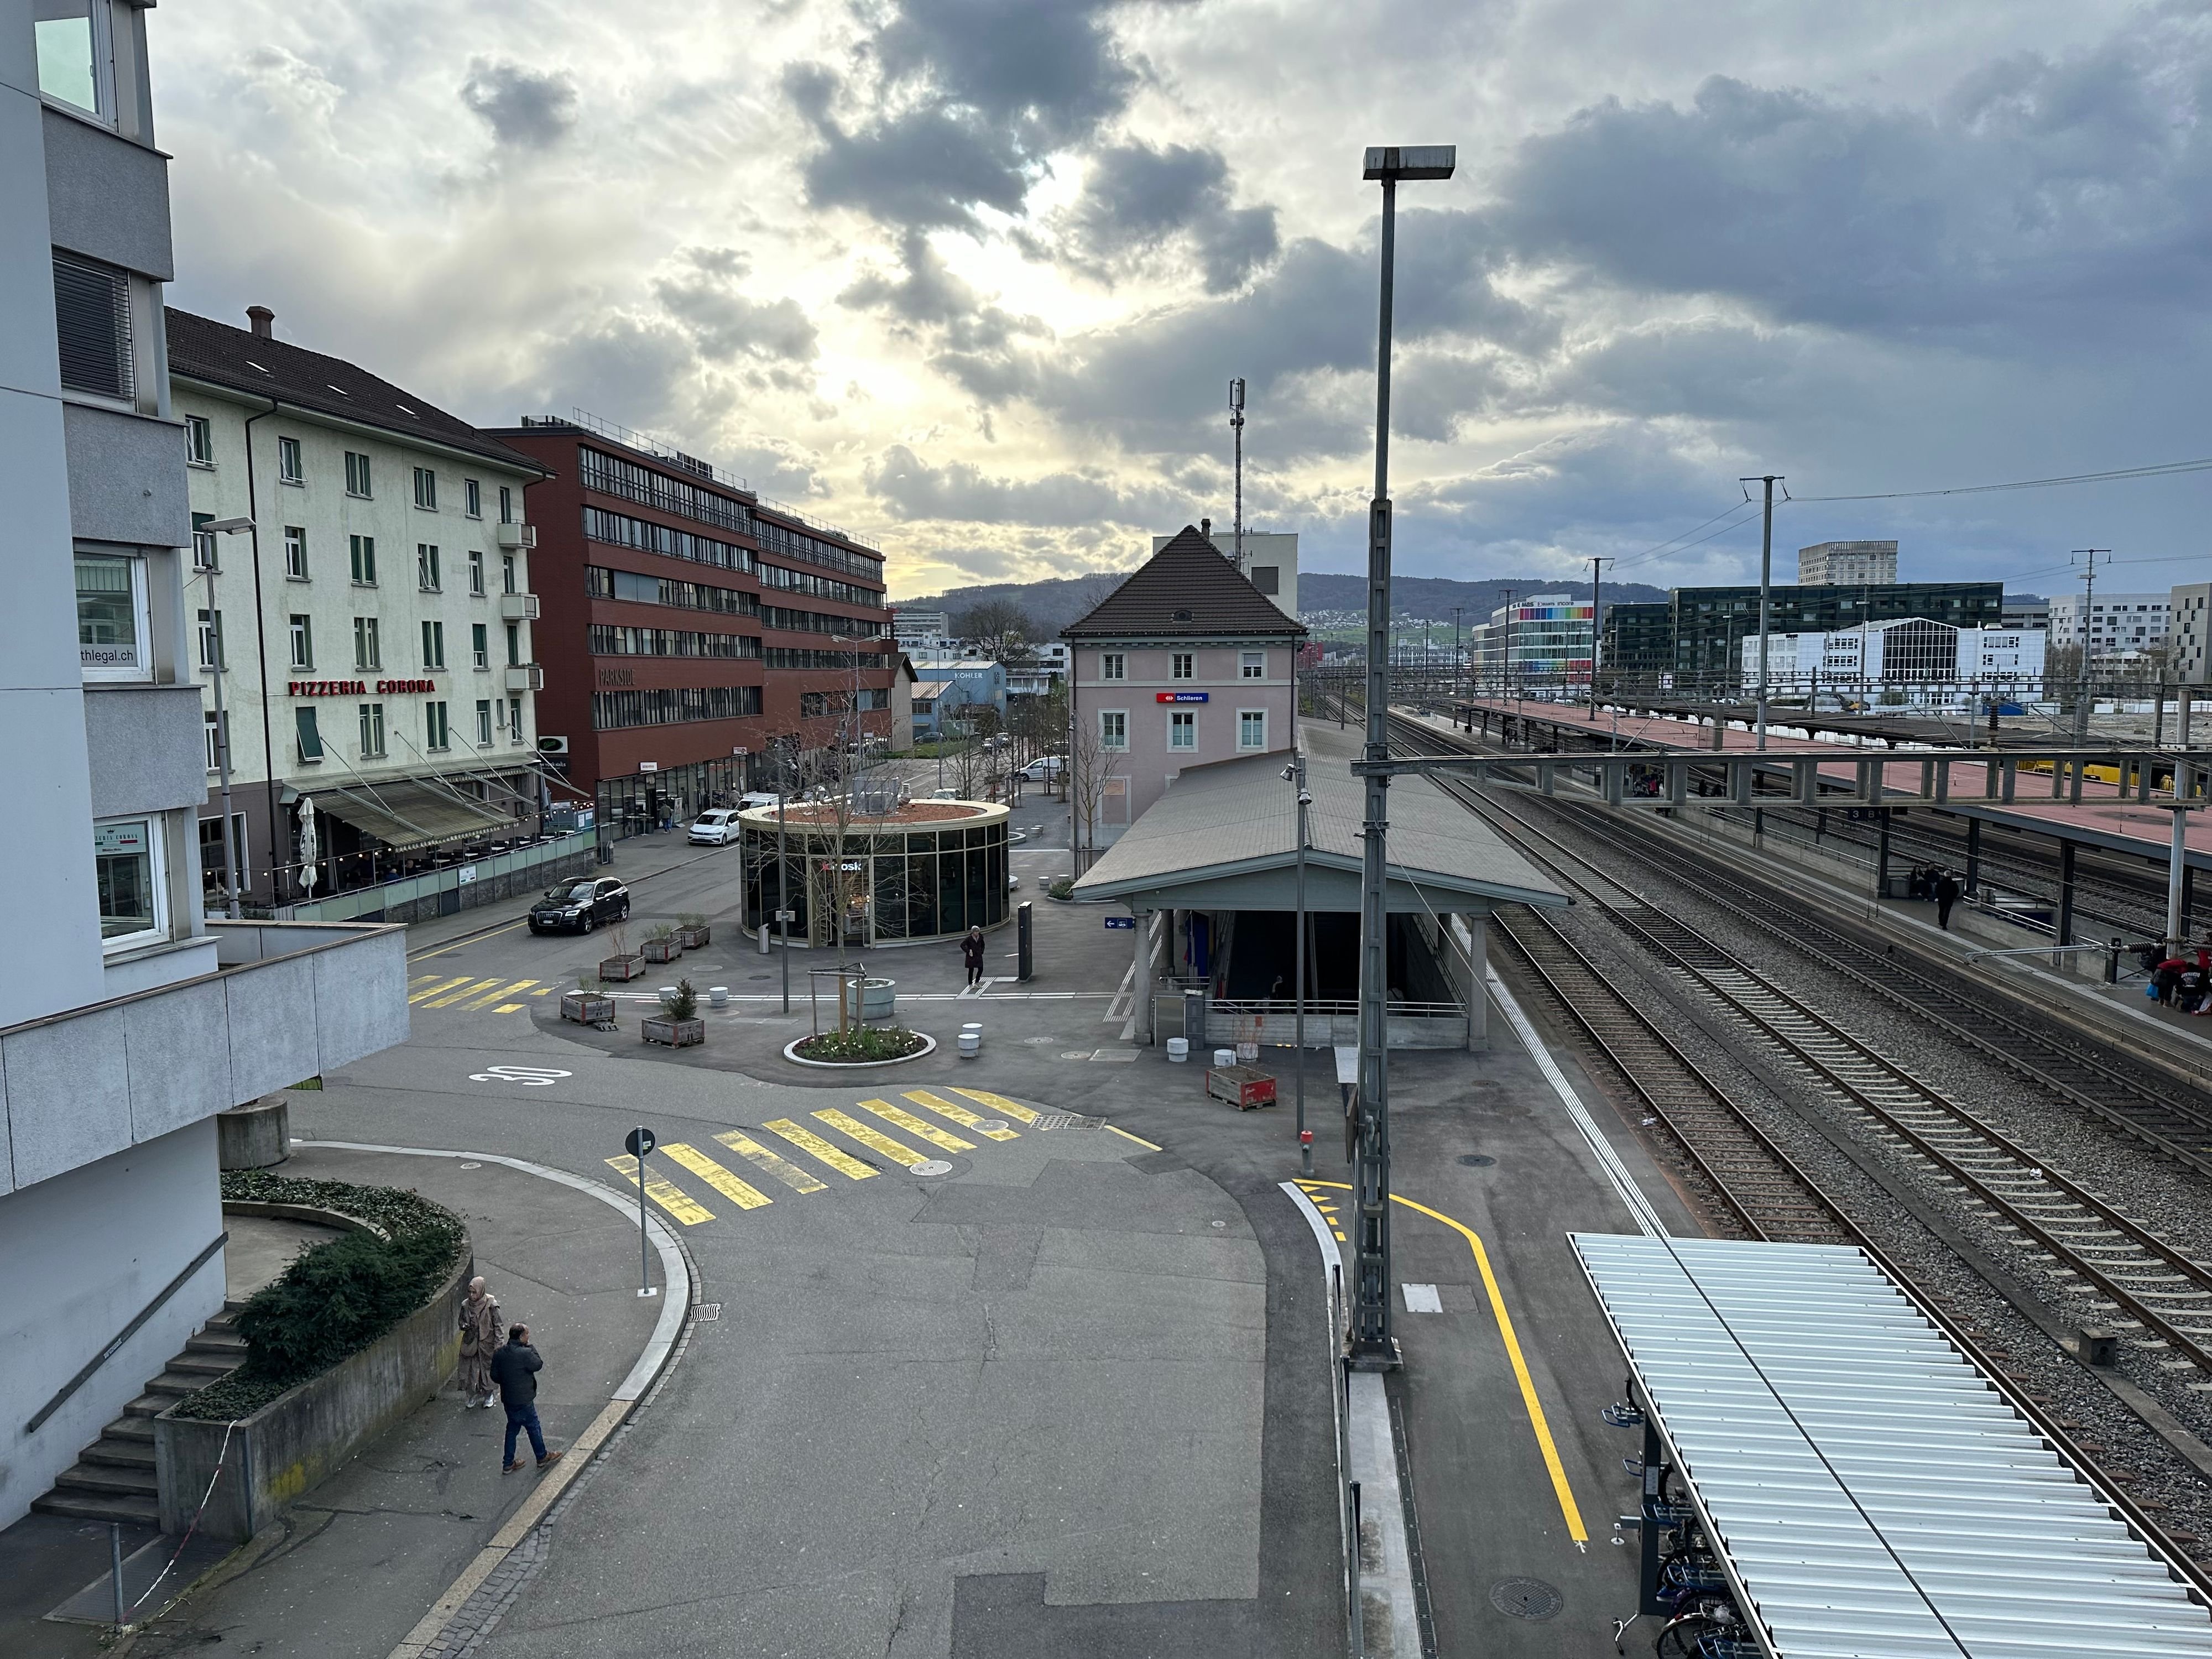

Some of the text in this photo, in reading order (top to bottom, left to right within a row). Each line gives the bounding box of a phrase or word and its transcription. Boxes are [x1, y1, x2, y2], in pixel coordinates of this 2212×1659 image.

[80, 649, 133, 664] thlegal.ch
[599, 668, 637, 686] PARKSIDE
[288, 680, 436, 696] PIZZERIA CORONA
